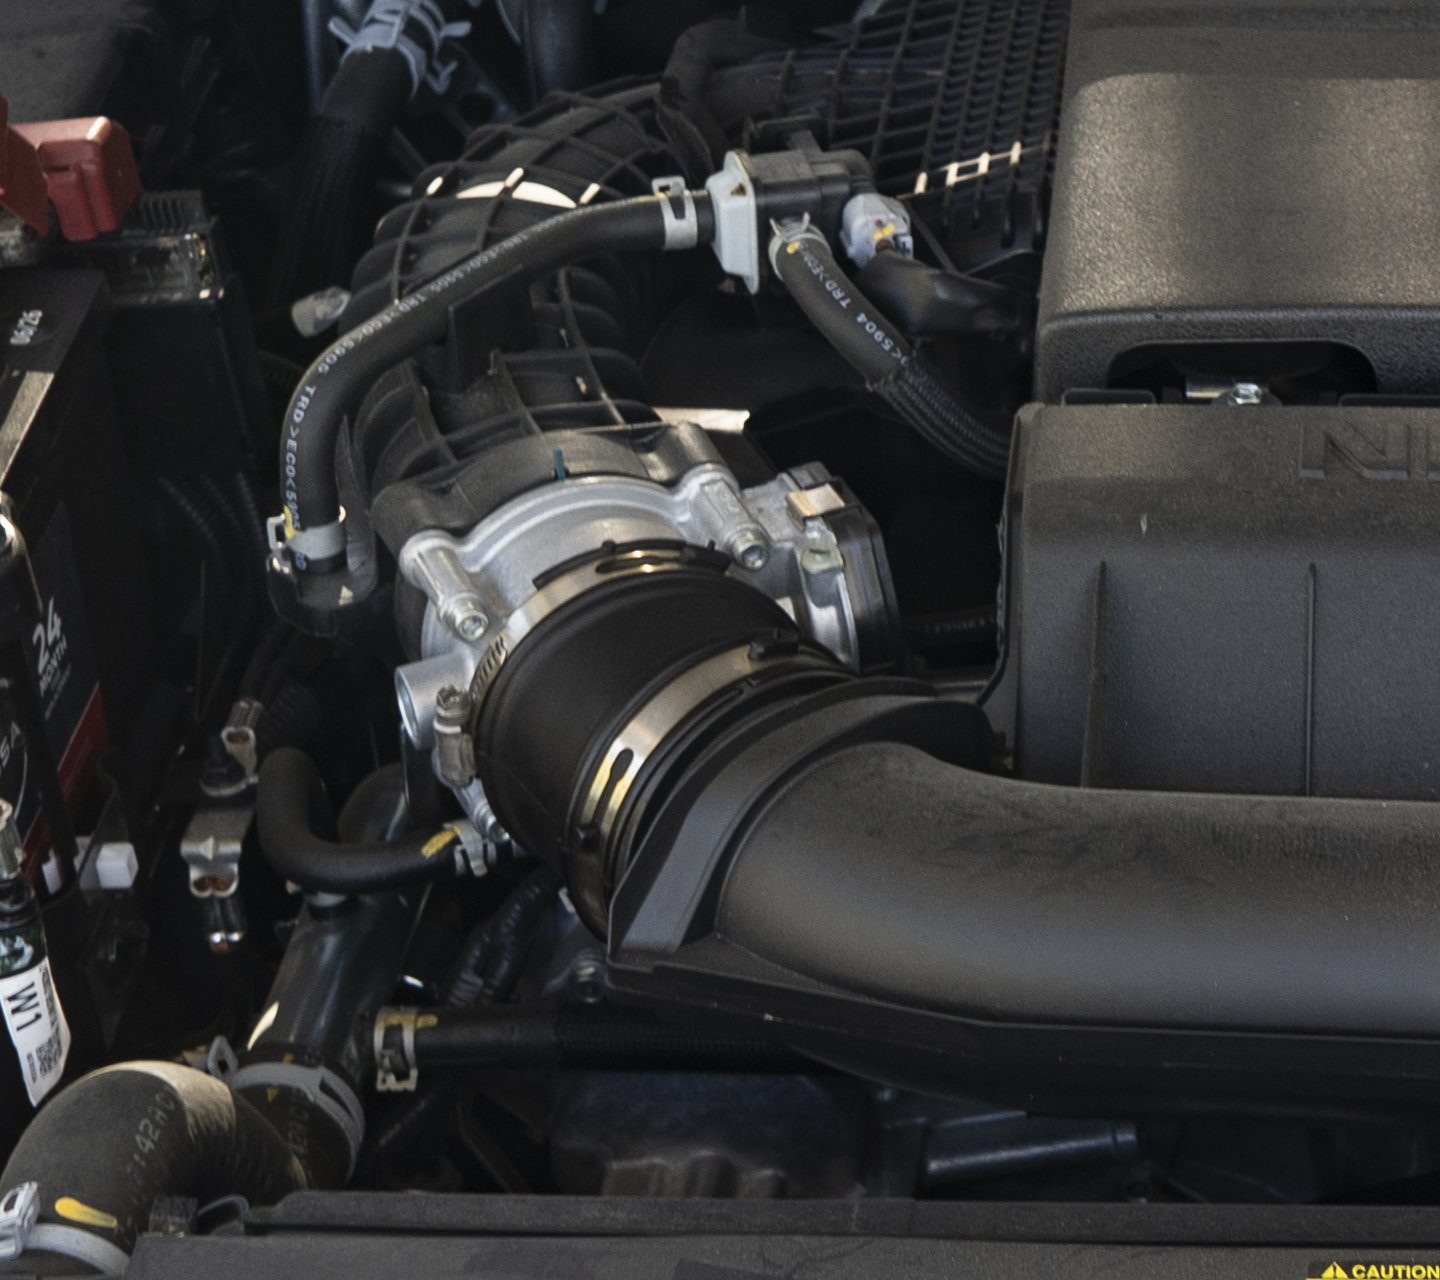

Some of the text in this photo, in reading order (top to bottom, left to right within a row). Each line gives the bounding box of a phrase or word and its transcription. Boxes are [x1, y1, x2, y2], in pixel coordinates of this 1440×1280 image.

[32, 595, 62, 676] 24
[39, 635, 68, 697] MONTH
[4, 981, 42, 1032] W1
[1351, 1264, 1440, 1279] CAUTION
